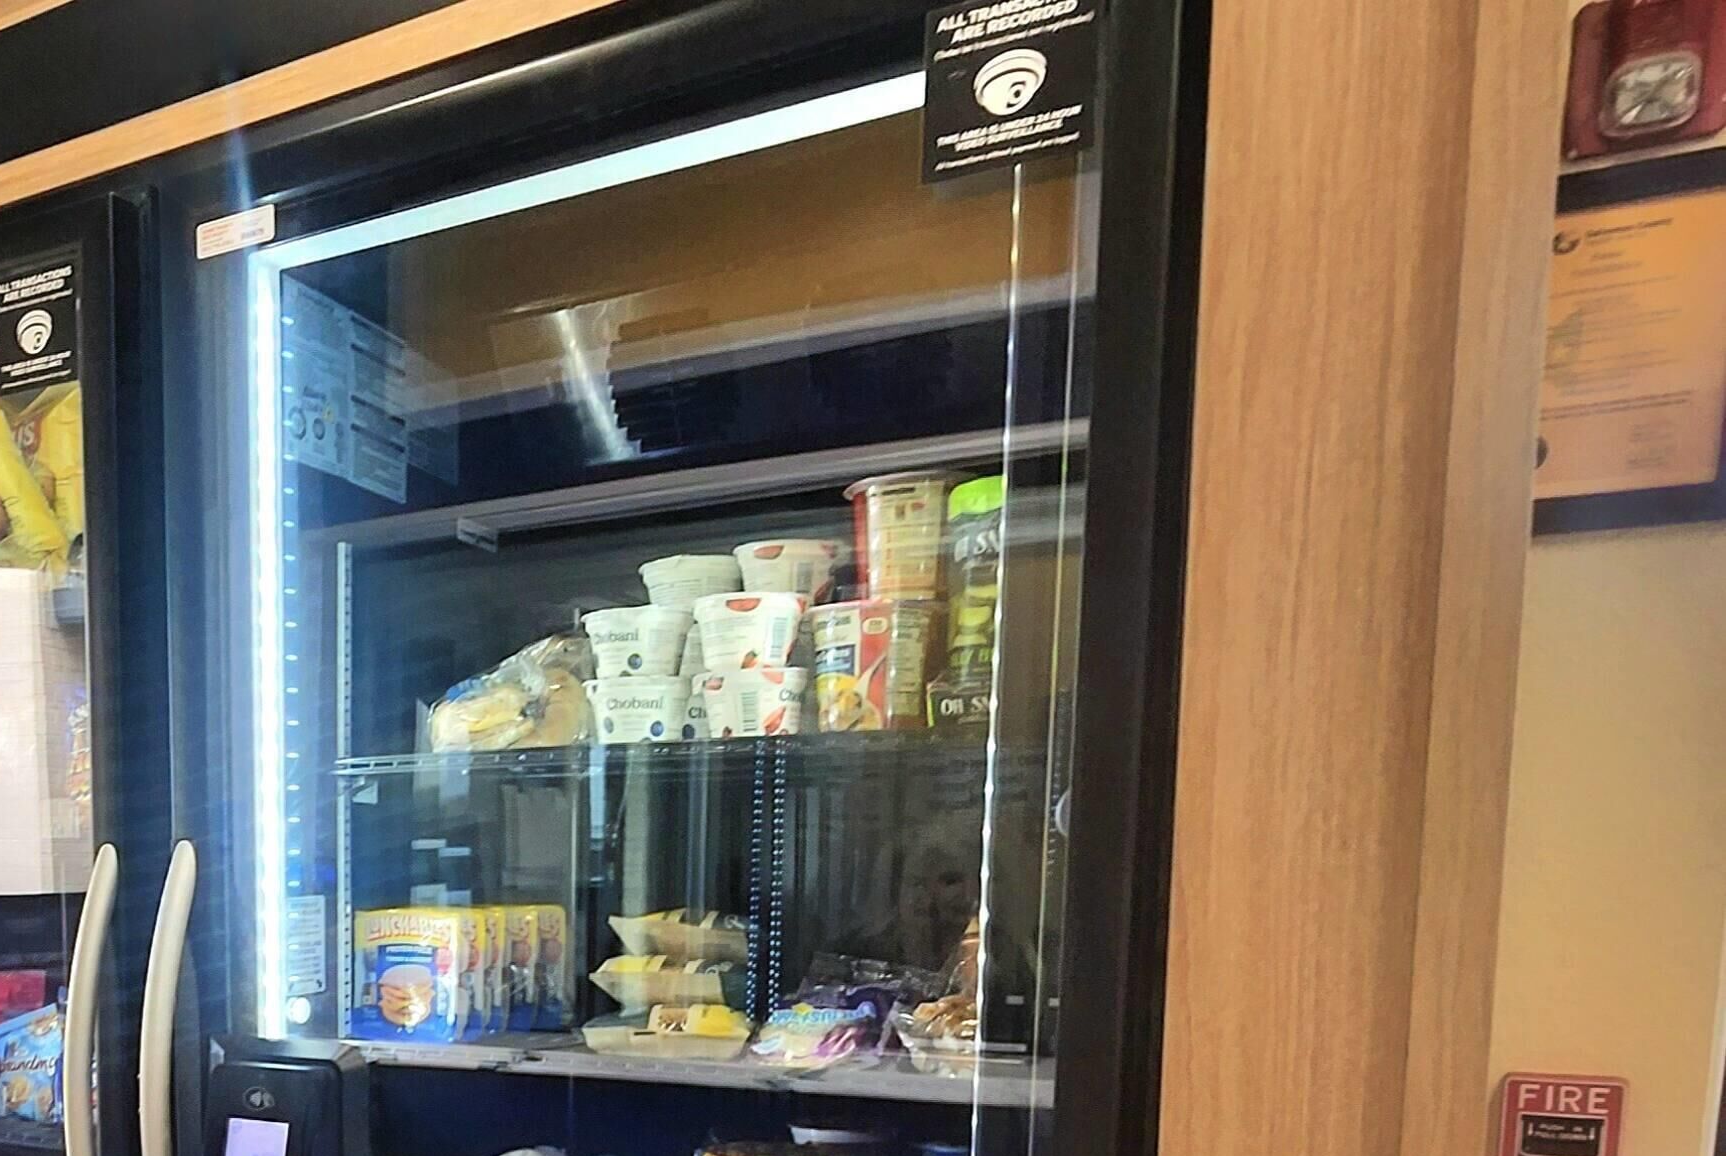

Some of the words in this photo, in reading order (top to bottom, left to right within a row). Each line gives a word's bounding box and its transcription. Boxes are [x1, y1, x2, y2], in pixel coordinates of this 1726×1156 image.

[936, 12, 968, 34] ALL
[950, 22, 986, 44] ARE
[985, 0, 1078, 35] RECORDED
[607, 695, 664, 711] Chobani
[1517, 1083, 1611, 1114] FIRE
